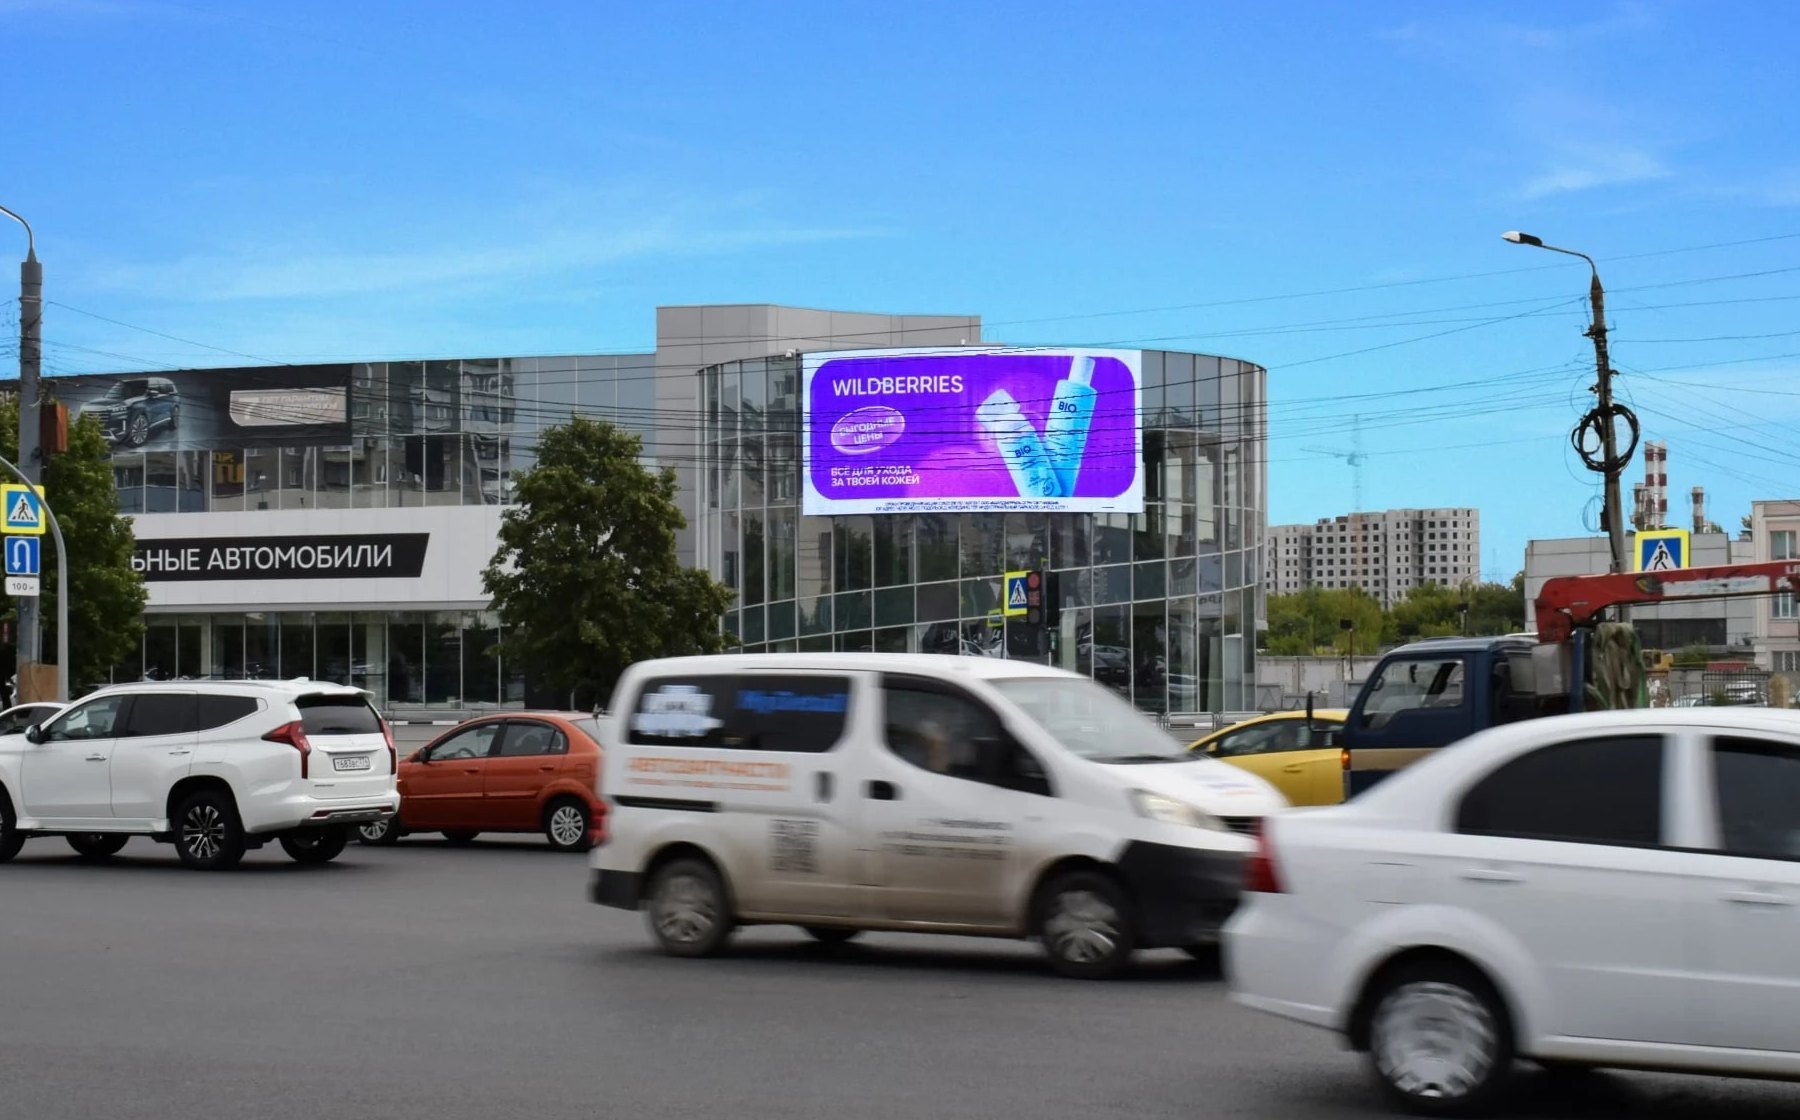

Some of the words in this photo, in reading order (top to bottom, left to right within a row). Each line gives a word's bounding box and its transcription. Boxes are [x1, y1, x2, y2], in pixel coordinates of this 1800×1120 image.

[832, 375, 964, 396] WILDBERRIES
[1058, 401, 1078, 413] BIO
[854, 432, 883, 445] ЦЕНЫ
[1014, 445, 1032, 458] BIO
[852, 467, 874, 477] ДЛЯ
[876, 466, 912, 475] УХОДА
[831, 477, 844, 487] ЗА
[846, 475, 880, 486] ТВОЕЙ
[881, 474, 920, 485] КОЖЕЙ
[207, 544, 392, 570] АВТОМОБИЛИ
[12, 582, 28, 591] 100
